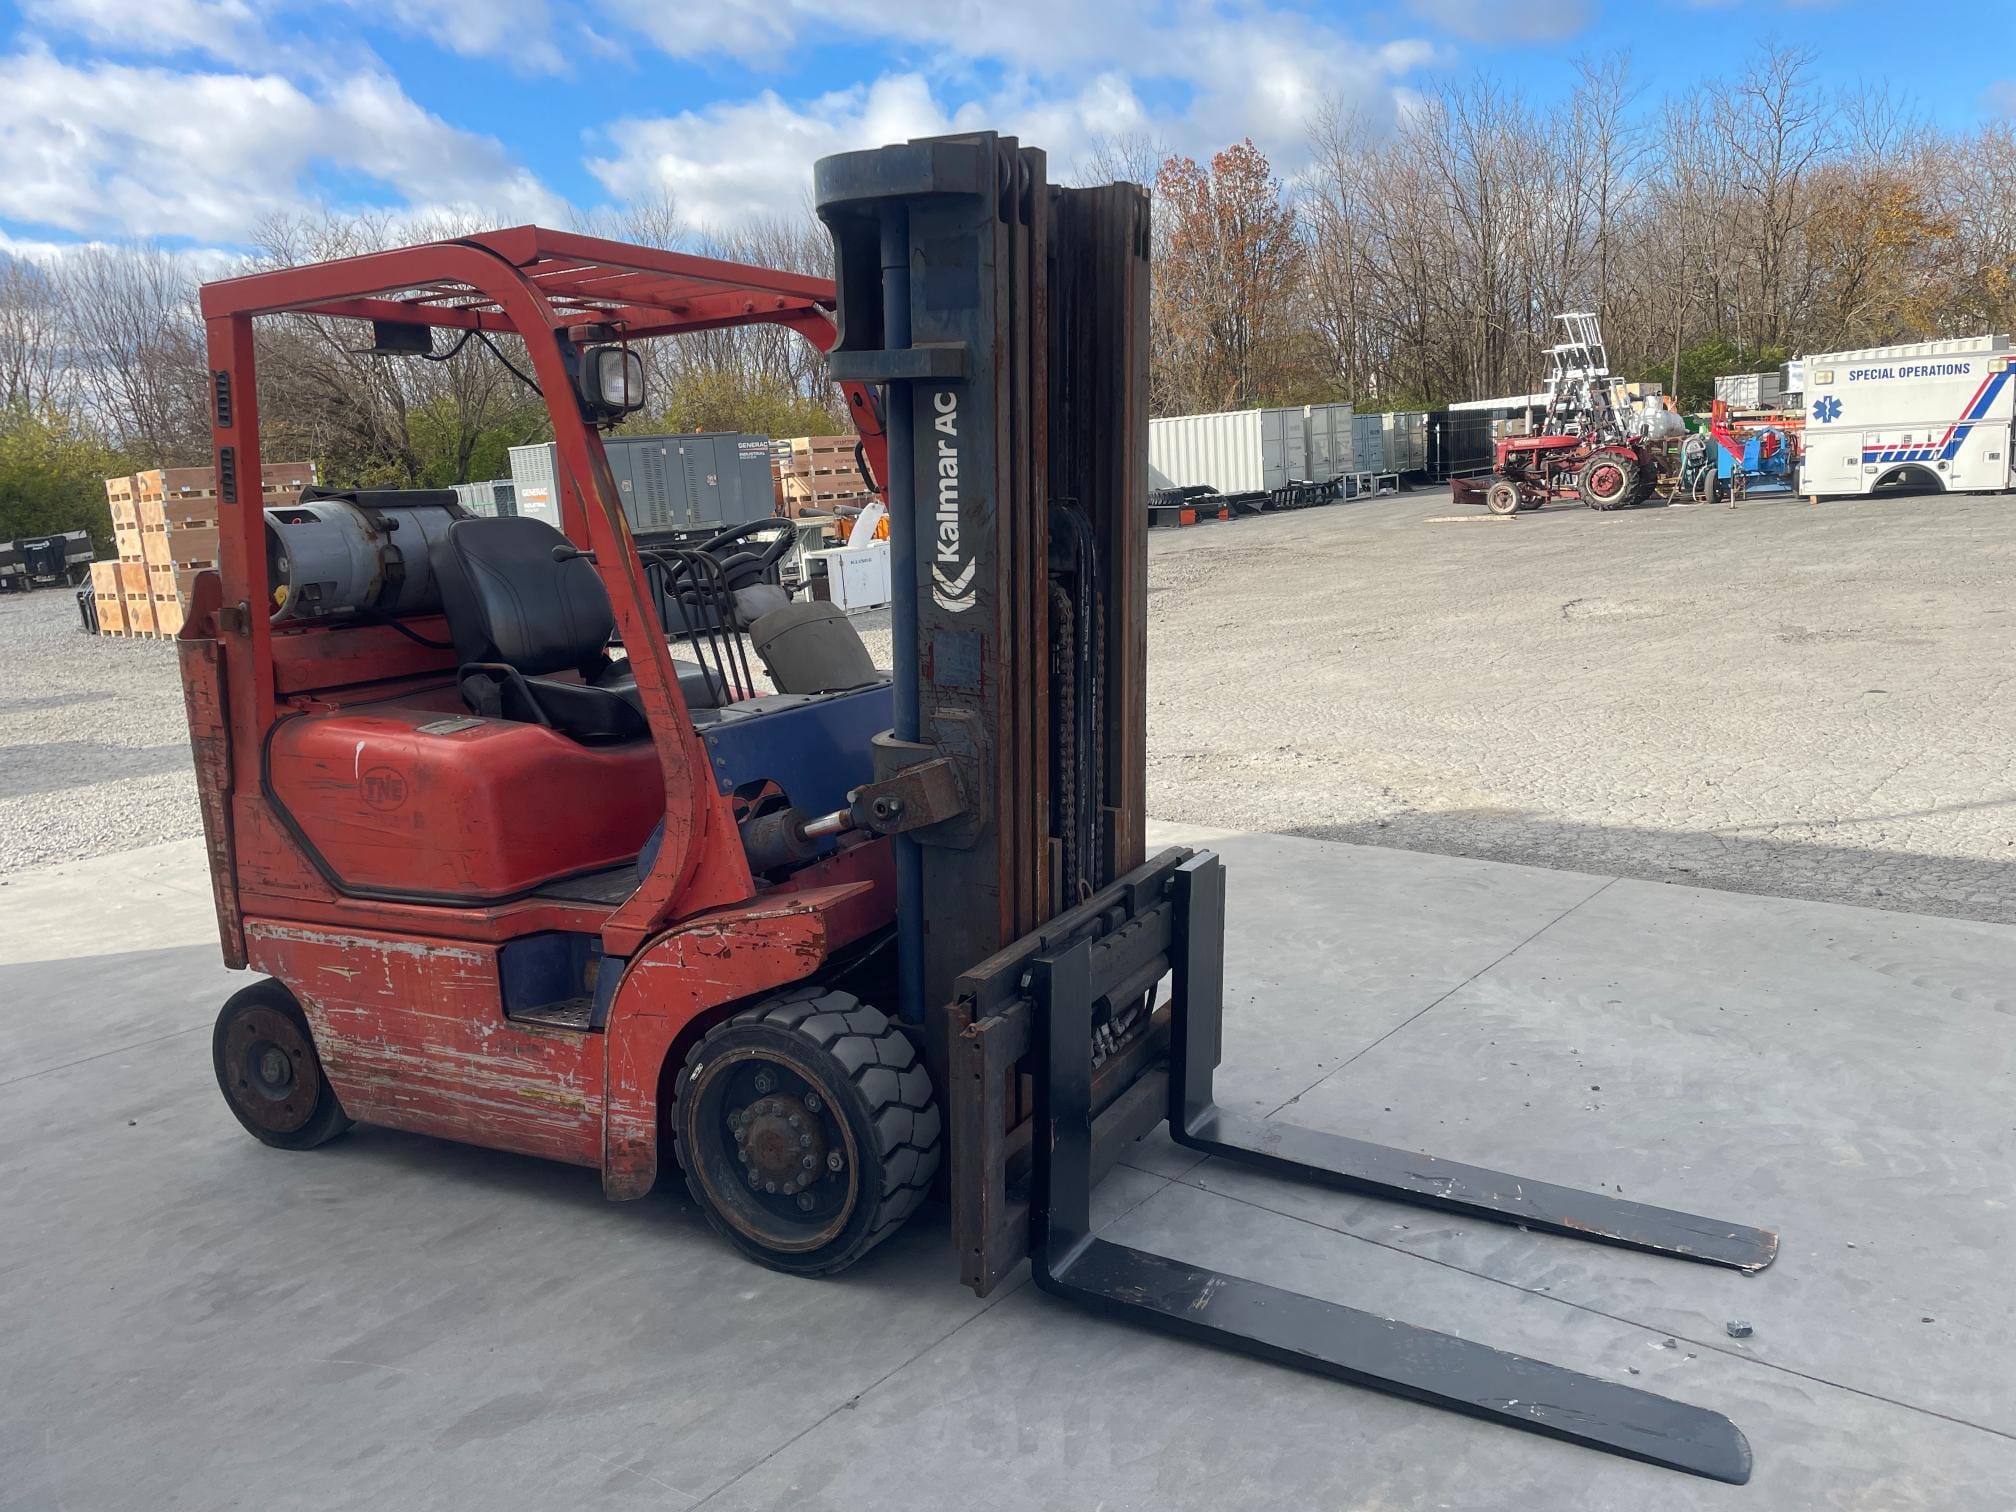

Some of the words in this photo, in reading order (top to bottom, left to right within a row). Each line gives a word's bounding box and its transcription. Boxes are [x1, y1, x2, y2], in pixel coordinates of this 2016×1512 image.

[1849, 368, 1895, 382] SPECIAL
[1898, 363, 1971, 378] OPERATIONS
[933, 392, 958, 437] AC
[738, 441, 768, 449] GENERAC
[935, 439, 960, 562] Kalmar
